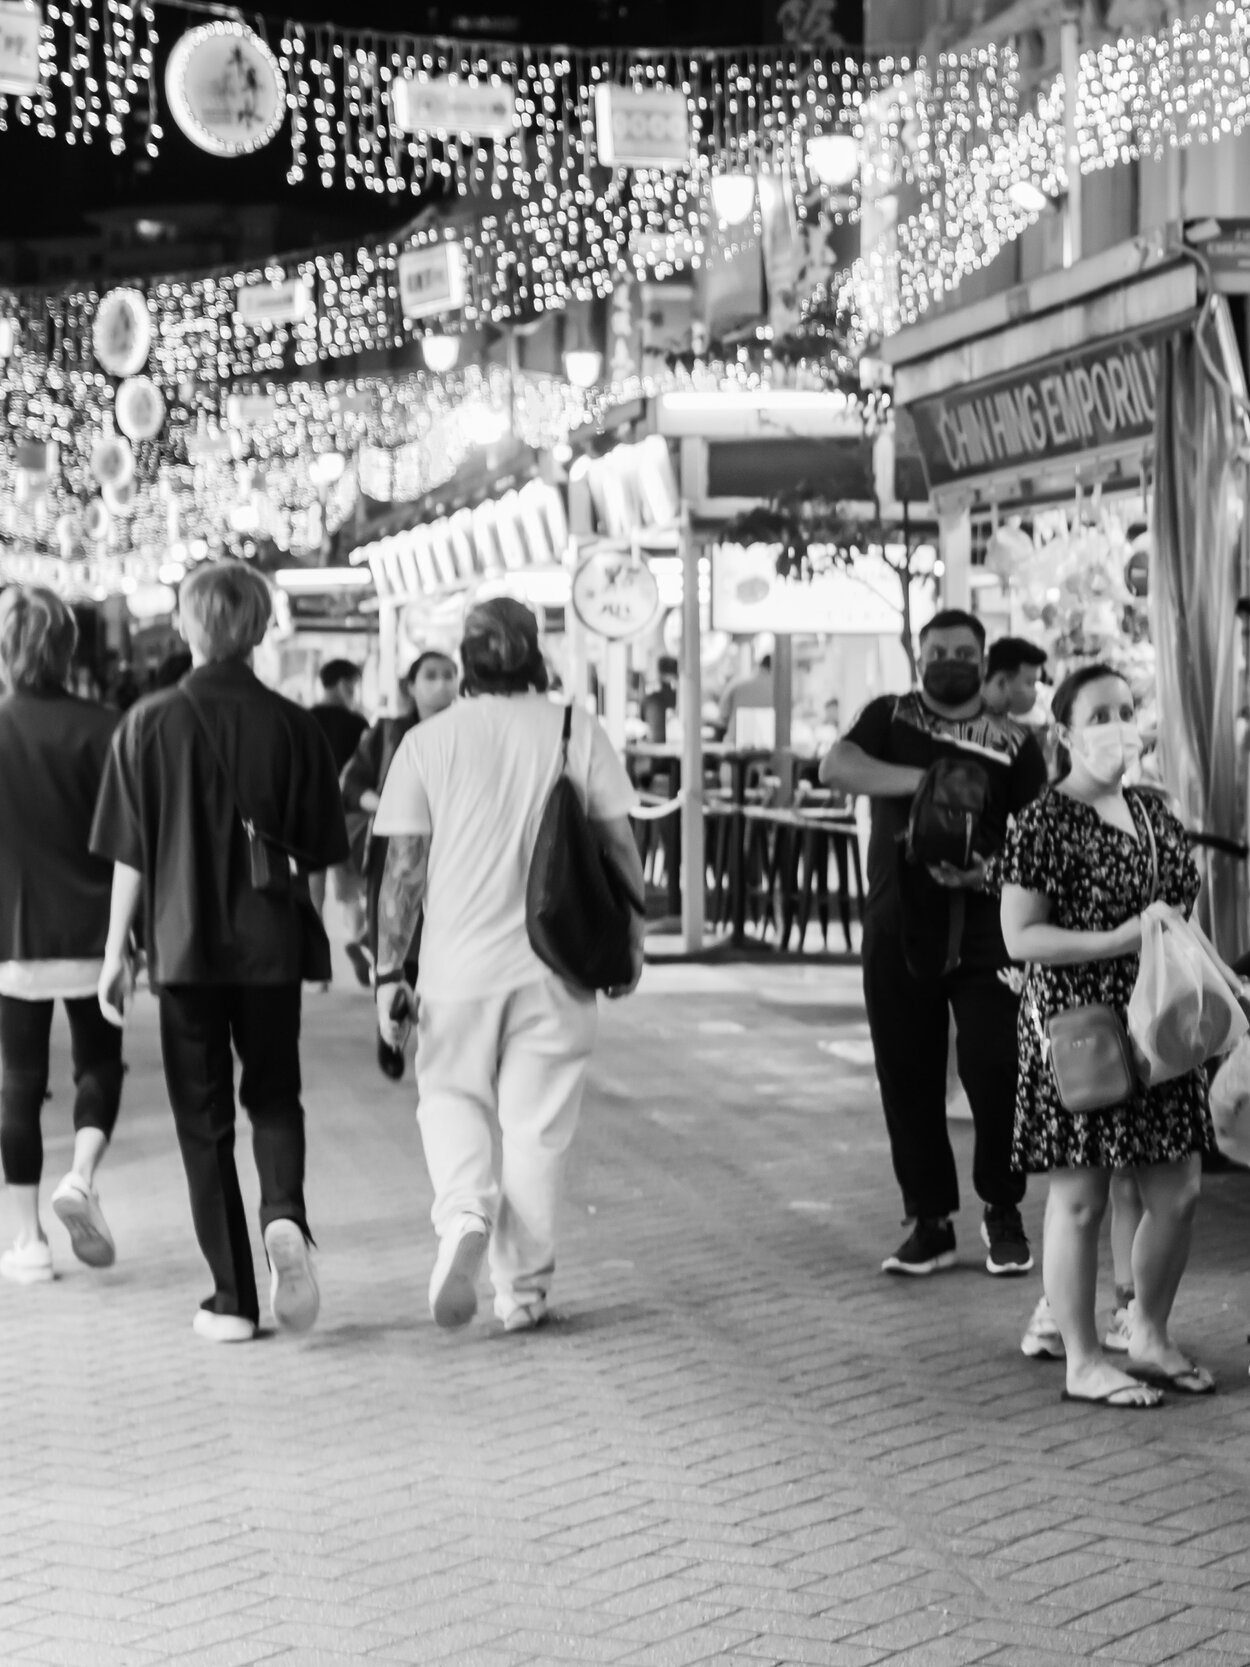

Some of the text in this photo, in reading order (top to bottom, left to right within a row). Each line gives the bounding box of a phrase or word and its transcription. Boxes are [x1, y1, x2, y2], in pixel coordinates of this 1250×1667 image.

[938, 347, 1157, 472] CHIN HING EMPORIU
